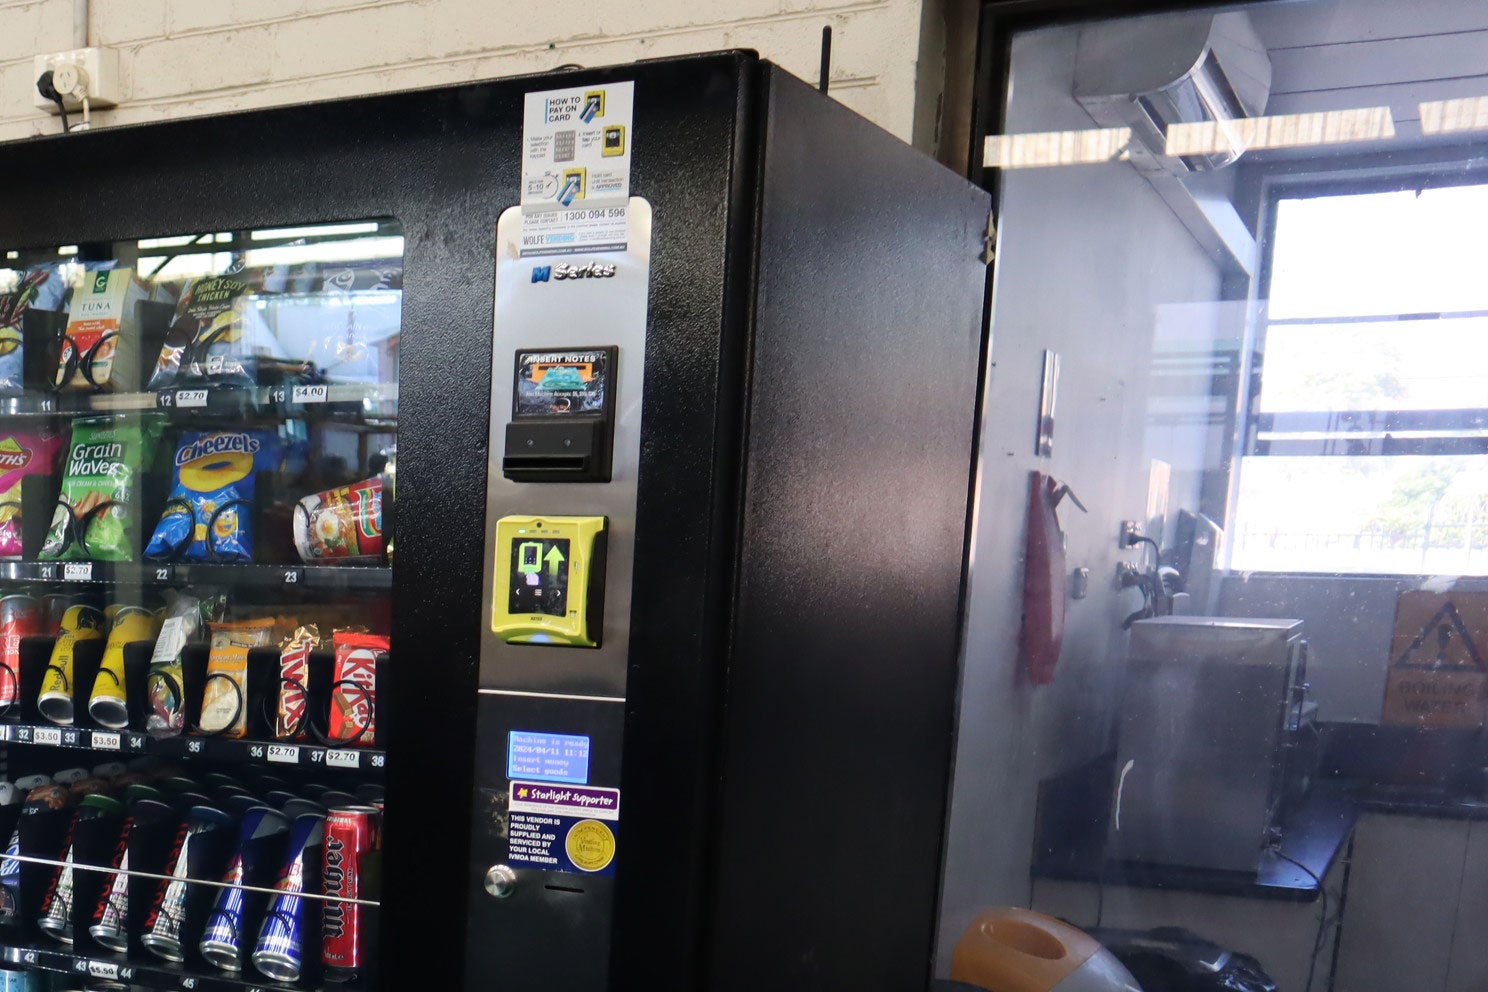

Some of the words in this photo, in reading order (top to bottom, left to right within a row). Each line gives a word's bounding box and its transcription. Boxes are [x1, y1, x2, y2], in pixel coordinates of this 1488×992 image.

[549, 98, 567, 106] HOW
[549, 114, 570, 122] CARD
[565, 212, 586, 220] 1300
[589, 210, 605, 218] 094
[609, 208, 625, 217] 596
[523, 235, 544, 245] WOLFE
[531, 266, 551, 283] M
[554, 261, 616, 280] Series
[195, 280, 225, 294] HONEY
[227, 278, 245, 289] SOY
[197, 291, 231, 301] CHICKEN
[81, 302, 111, 312] TUNA
[160, 395, 172, 407] 12
[178, 392, 204, 401] $2.70
[273, 391, 284, 402] 13
[296, 388, 323, 397] $4.00
[41, 401, 51, 411] 11
[73, 443, 121, 459] Grain
[176, 433, 260, 465] Cheezels
[69, 460, 119, 476] Waves
[42, 567, 52, 578] 21
[66, 566, 89, 575] $2.70
[156, 569, 168, 580] 22
[284, 571, 297, 583] 23
[19, 730, 29, 740] 32
[35, 731, 58, 740] $3.50
[65, 733, 75, 743] 33
[94, 736, 117, 745] $3.50
[131, 737, 142, 748] 34
[189, 741, 200, 753] 35
[251, 747, 262, 758] 36
[269, 747, 295, 757] $2.70
[311, 751, 324, 762] 37
[328, 751, 356, 762] $2.70
[371, 756, 384, 767] 38
[514, 756, 540, 764] Insert
[513, 765, 540, 773] Select
[545, 768, 568, 776] goods
[531, 788, 571, 803] Starlight
[572, 793, 613, 806] Supporter
[511, 823, 540, 831] PROUDLY
[510, 831, 540, 839] SUPPLIED
[510, 839, 541, 847] SERVICED
[24, 953, 35, 963] 42
[76, 962, 87, 971] 43
[121, 968, 132, 978] 44
[183, 977, 194, 989] 45
